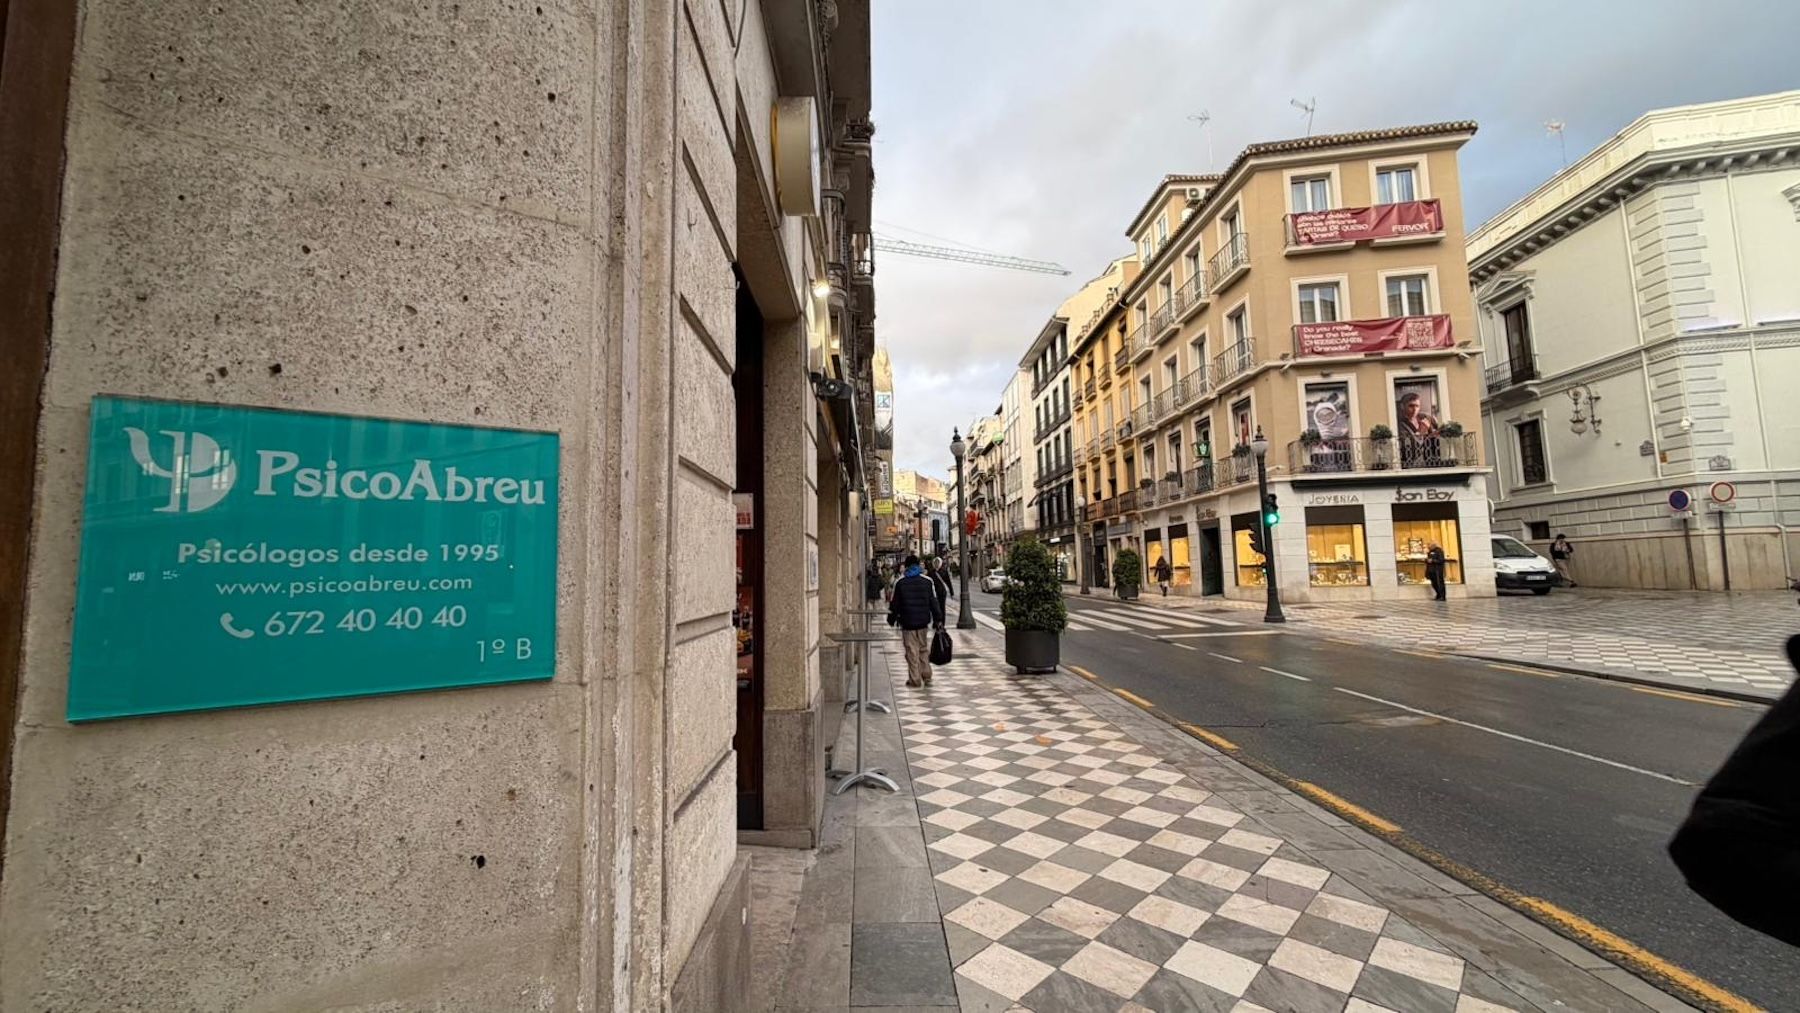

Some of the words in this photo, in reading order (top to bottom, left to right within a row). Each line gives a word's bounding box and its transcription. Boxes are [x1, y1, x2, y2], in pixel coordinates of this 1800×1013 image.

[1341, 223, 1369, 232] QUESO
[1392, 222, 1429, 232] FERVOR
[253, 449, 546, 505] PsicoAbreu
[178, 541, 339, 568] Psicólogos
[349, 543, 429, 563] desde
[440, 544, 500, 562] 1995
[215, 575, 472, 598] www.psicoabreu.com
[264, 610, 325, 637] 672
[336, 608, 377, 632] 40
[385, 606, 423, 630] 40
[431, 605, 467, 627] 40
[516, 637, 532, 660] B
